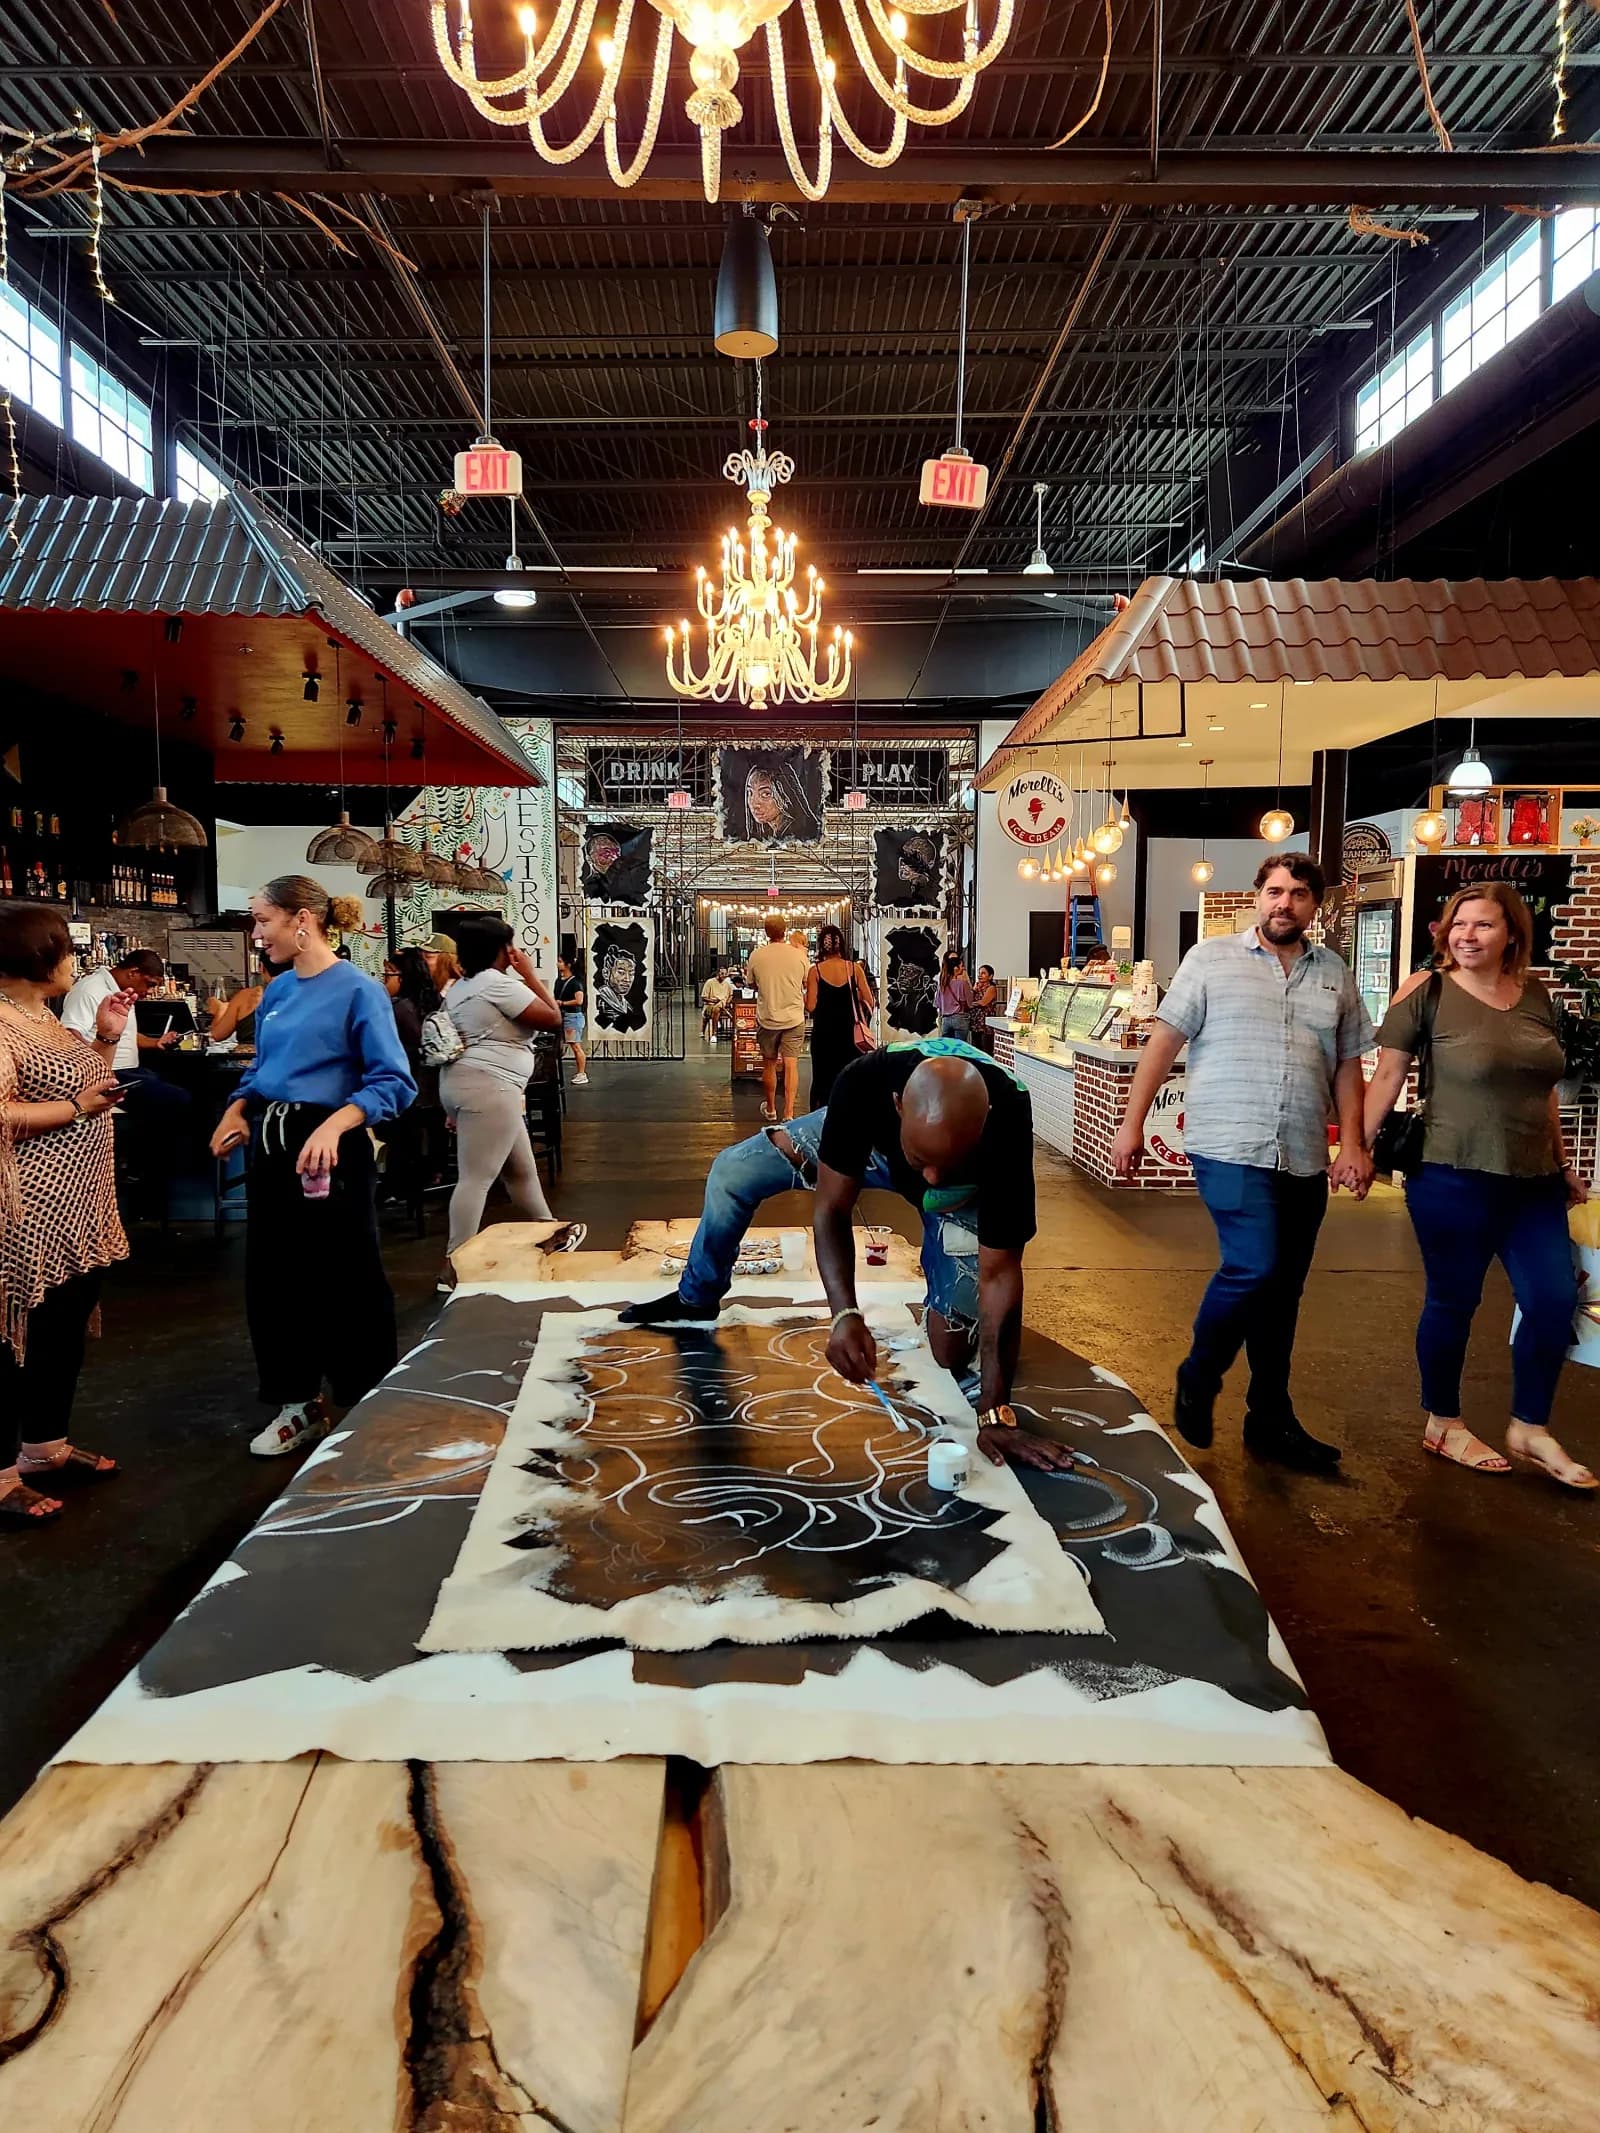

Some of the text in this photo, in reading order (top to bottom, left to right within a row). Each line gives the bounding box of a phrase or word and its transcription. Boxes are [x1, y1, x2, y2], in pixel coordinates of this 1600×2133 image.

[466, 453, 511, 490] EXIT
[932, 462, 981, 503] EXIT
[610, 762, 680, 780] DRINK
[862, 763, 915, 782] PLAY
[672, 793, 688, 806] EXIT
[1008, 775, 1065, 805] Morelli's
[847, 794, 864, 808] EXIT
[1010, 823, 1063, 843] ICE CREAM
[1374, 849, 1391, 857] ATL
[1439, 856, 1545, 880] Morelli's
[735, 1007, 757, 1017] WEEKL
[1152, 1087, 1185, 1118] Mor
[1153, 1140, 1173, 1160] ICE
